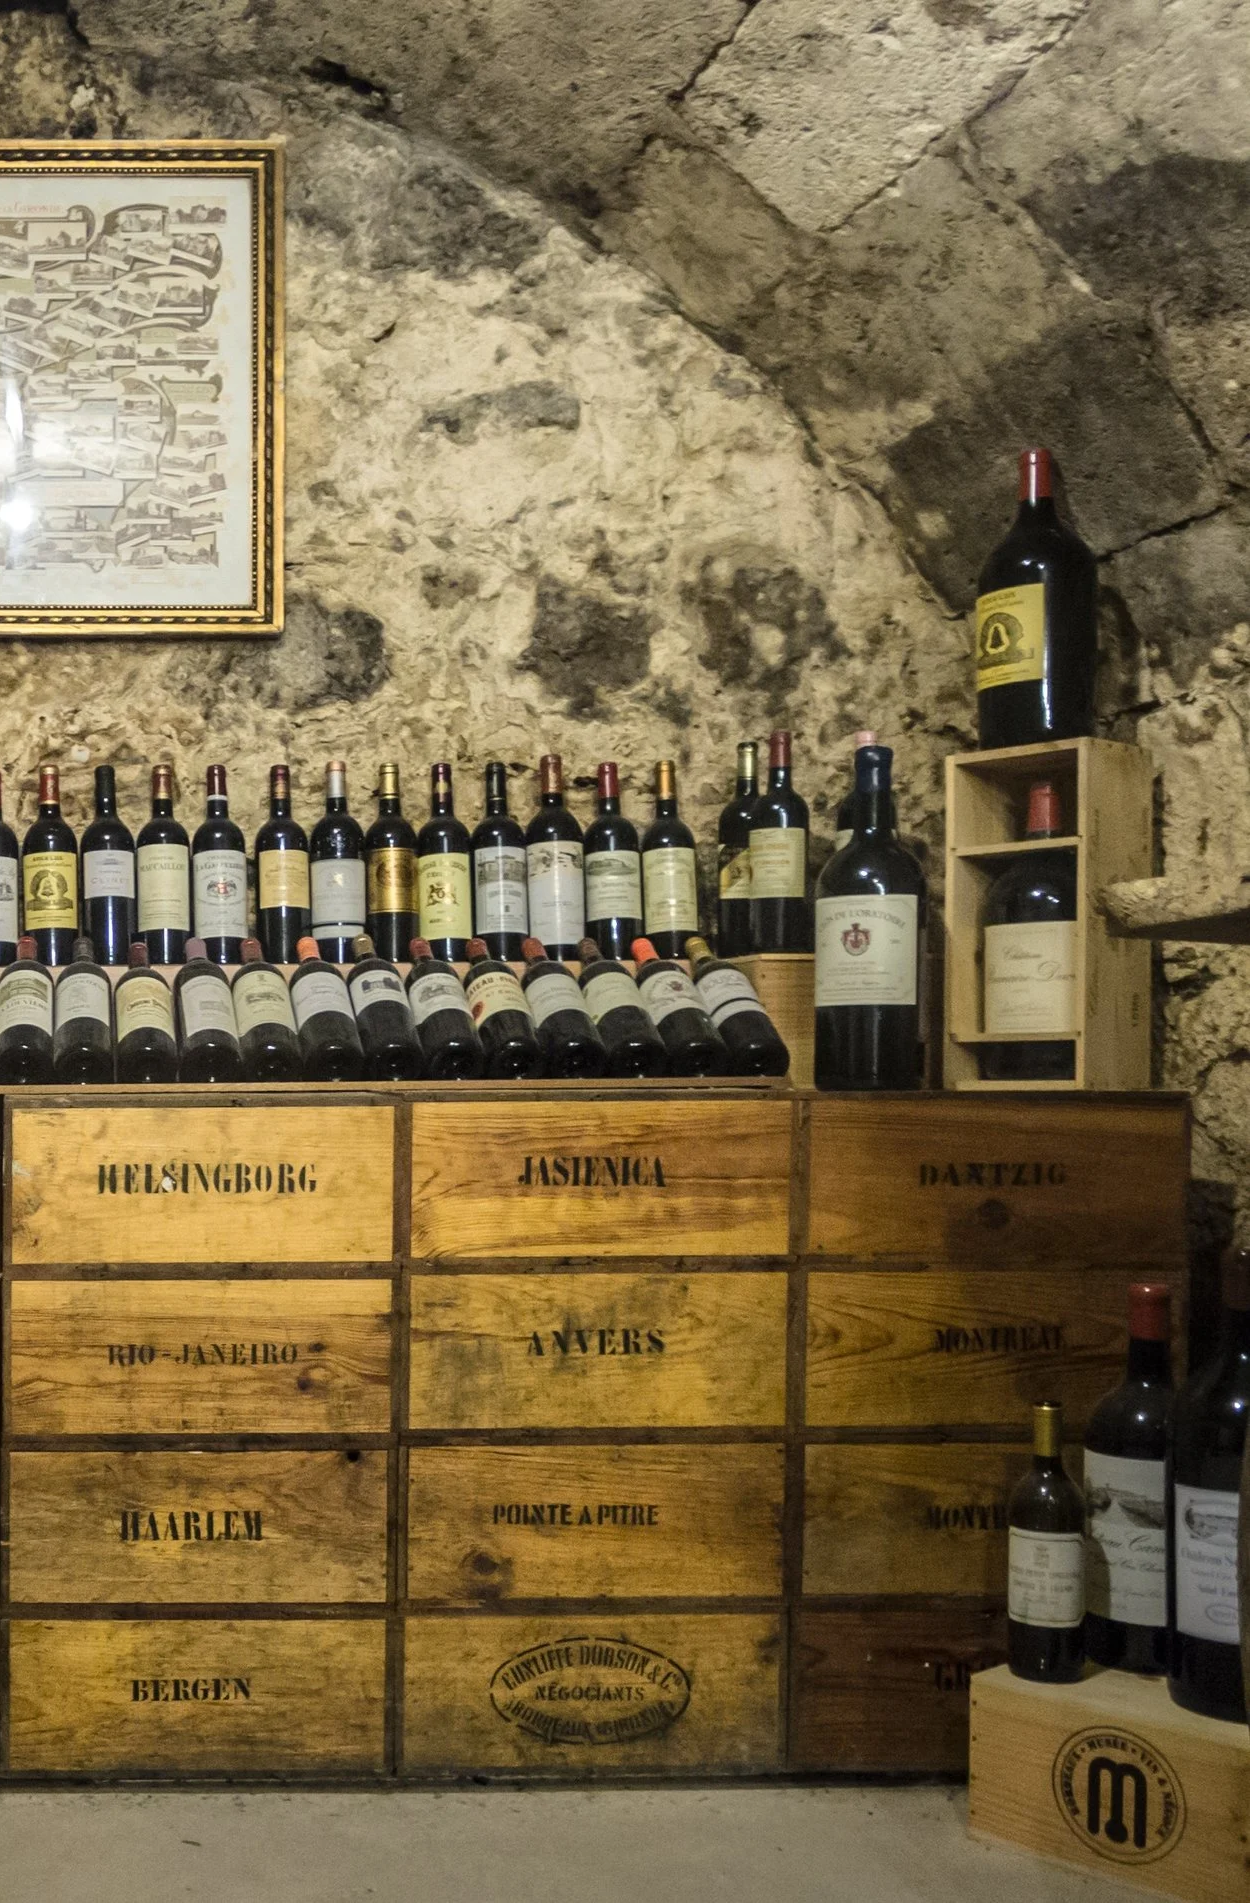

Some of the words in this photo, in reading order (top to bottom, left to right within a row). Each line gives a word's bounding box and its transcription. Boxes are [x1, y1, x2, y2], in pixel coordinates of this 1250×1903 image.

[97, 1162, 318, 1195] HELSINGBORG
[517, 1156, 667, 1187] JASIENICA
[919, 1162, 1068, 1187] DANTZIG
[527, 1328, 667, 1357] ANVERS
[120, 1510, 263, 1541] HAARLEM
[493, 1503, 572, 1526] POINTE
[597, 1504, 660, 1526] PITRE
[131, 1678, 252, 1702] BERGEN
